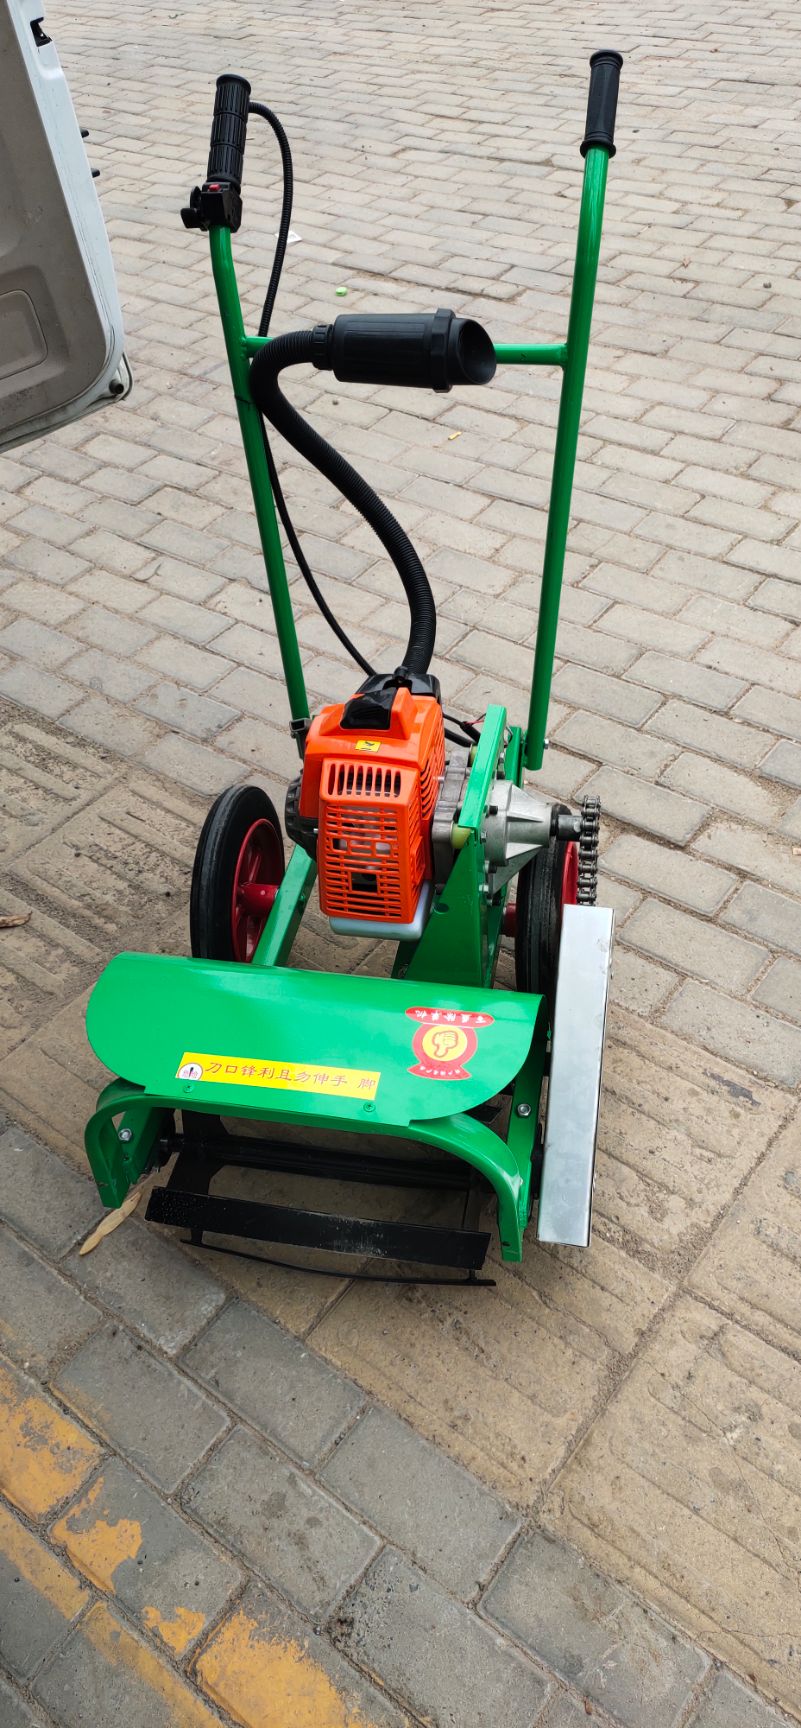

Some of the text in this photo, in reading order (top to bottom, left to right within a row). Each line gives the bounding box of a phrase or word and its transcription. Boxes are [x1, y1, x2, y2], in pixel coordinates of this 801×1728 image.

[205, 1062, 347, 1087] 刀口锋利且勿伸手
[357, 1078, 377, 1091] 脚
